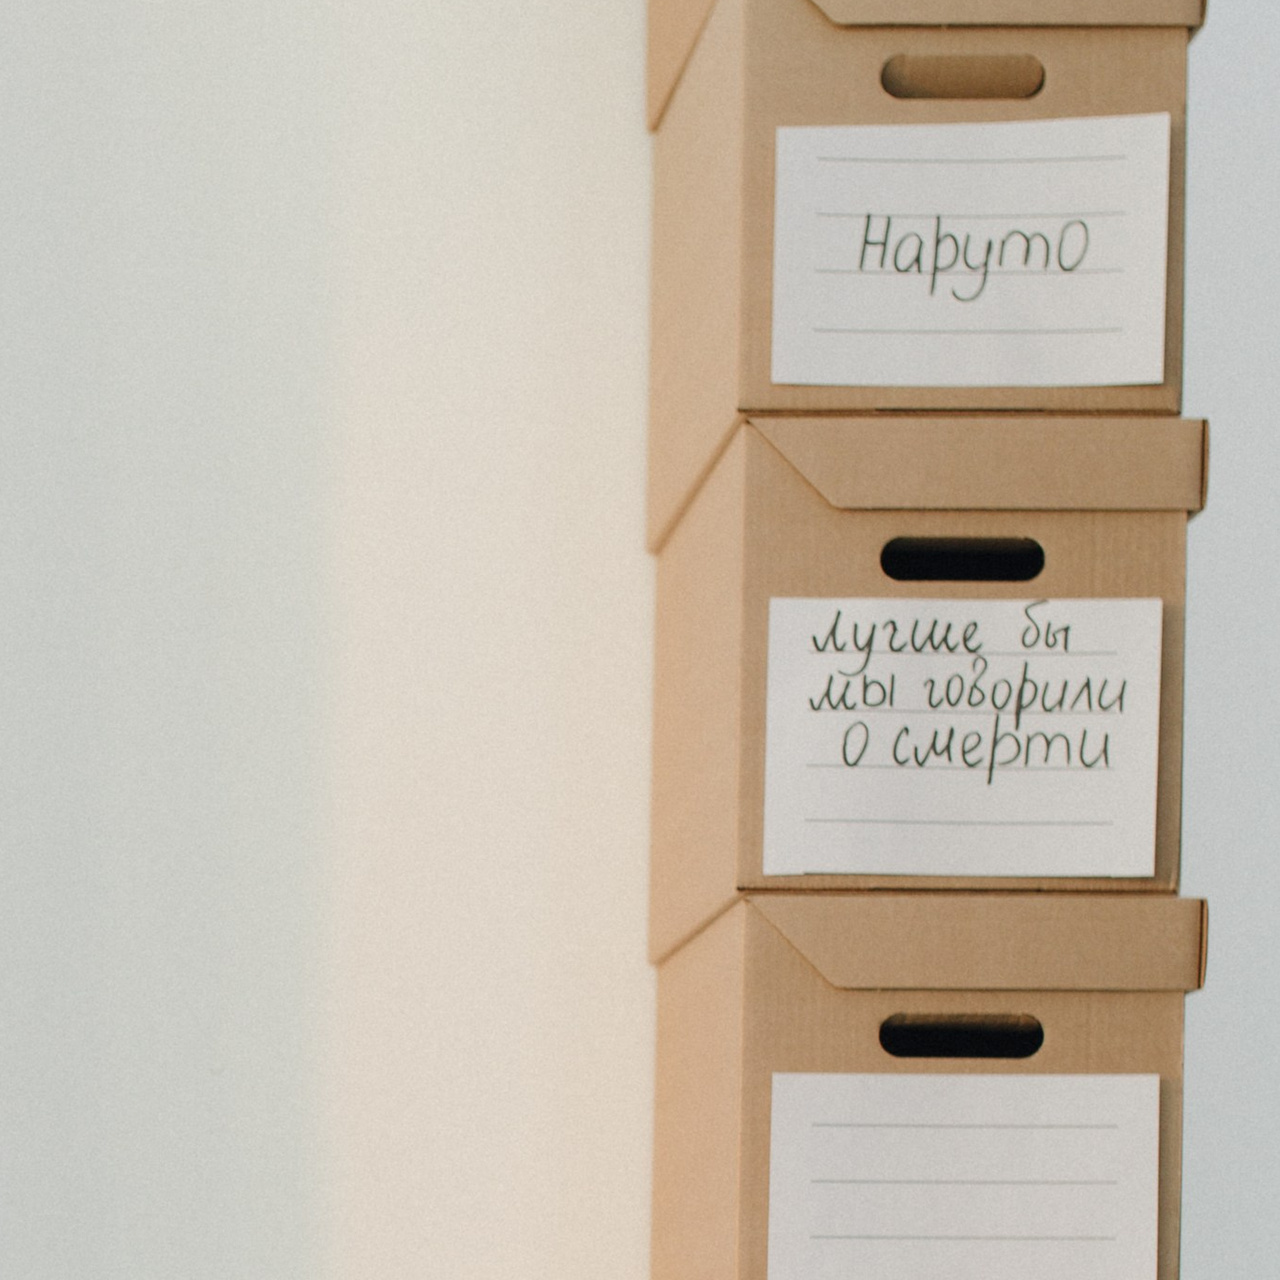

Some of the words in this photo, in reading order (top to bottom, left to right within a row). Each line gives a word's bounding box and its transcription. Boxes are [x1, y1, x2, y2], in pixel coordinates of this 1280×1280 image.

[858, 213, 1090, 303] Наруто
[1020, 599, 1072, 654] бы
[808, 672, 896, 712] мы
[923, 655, 1128, 731] говорили
[892, 713, 1111, 785] смерти
